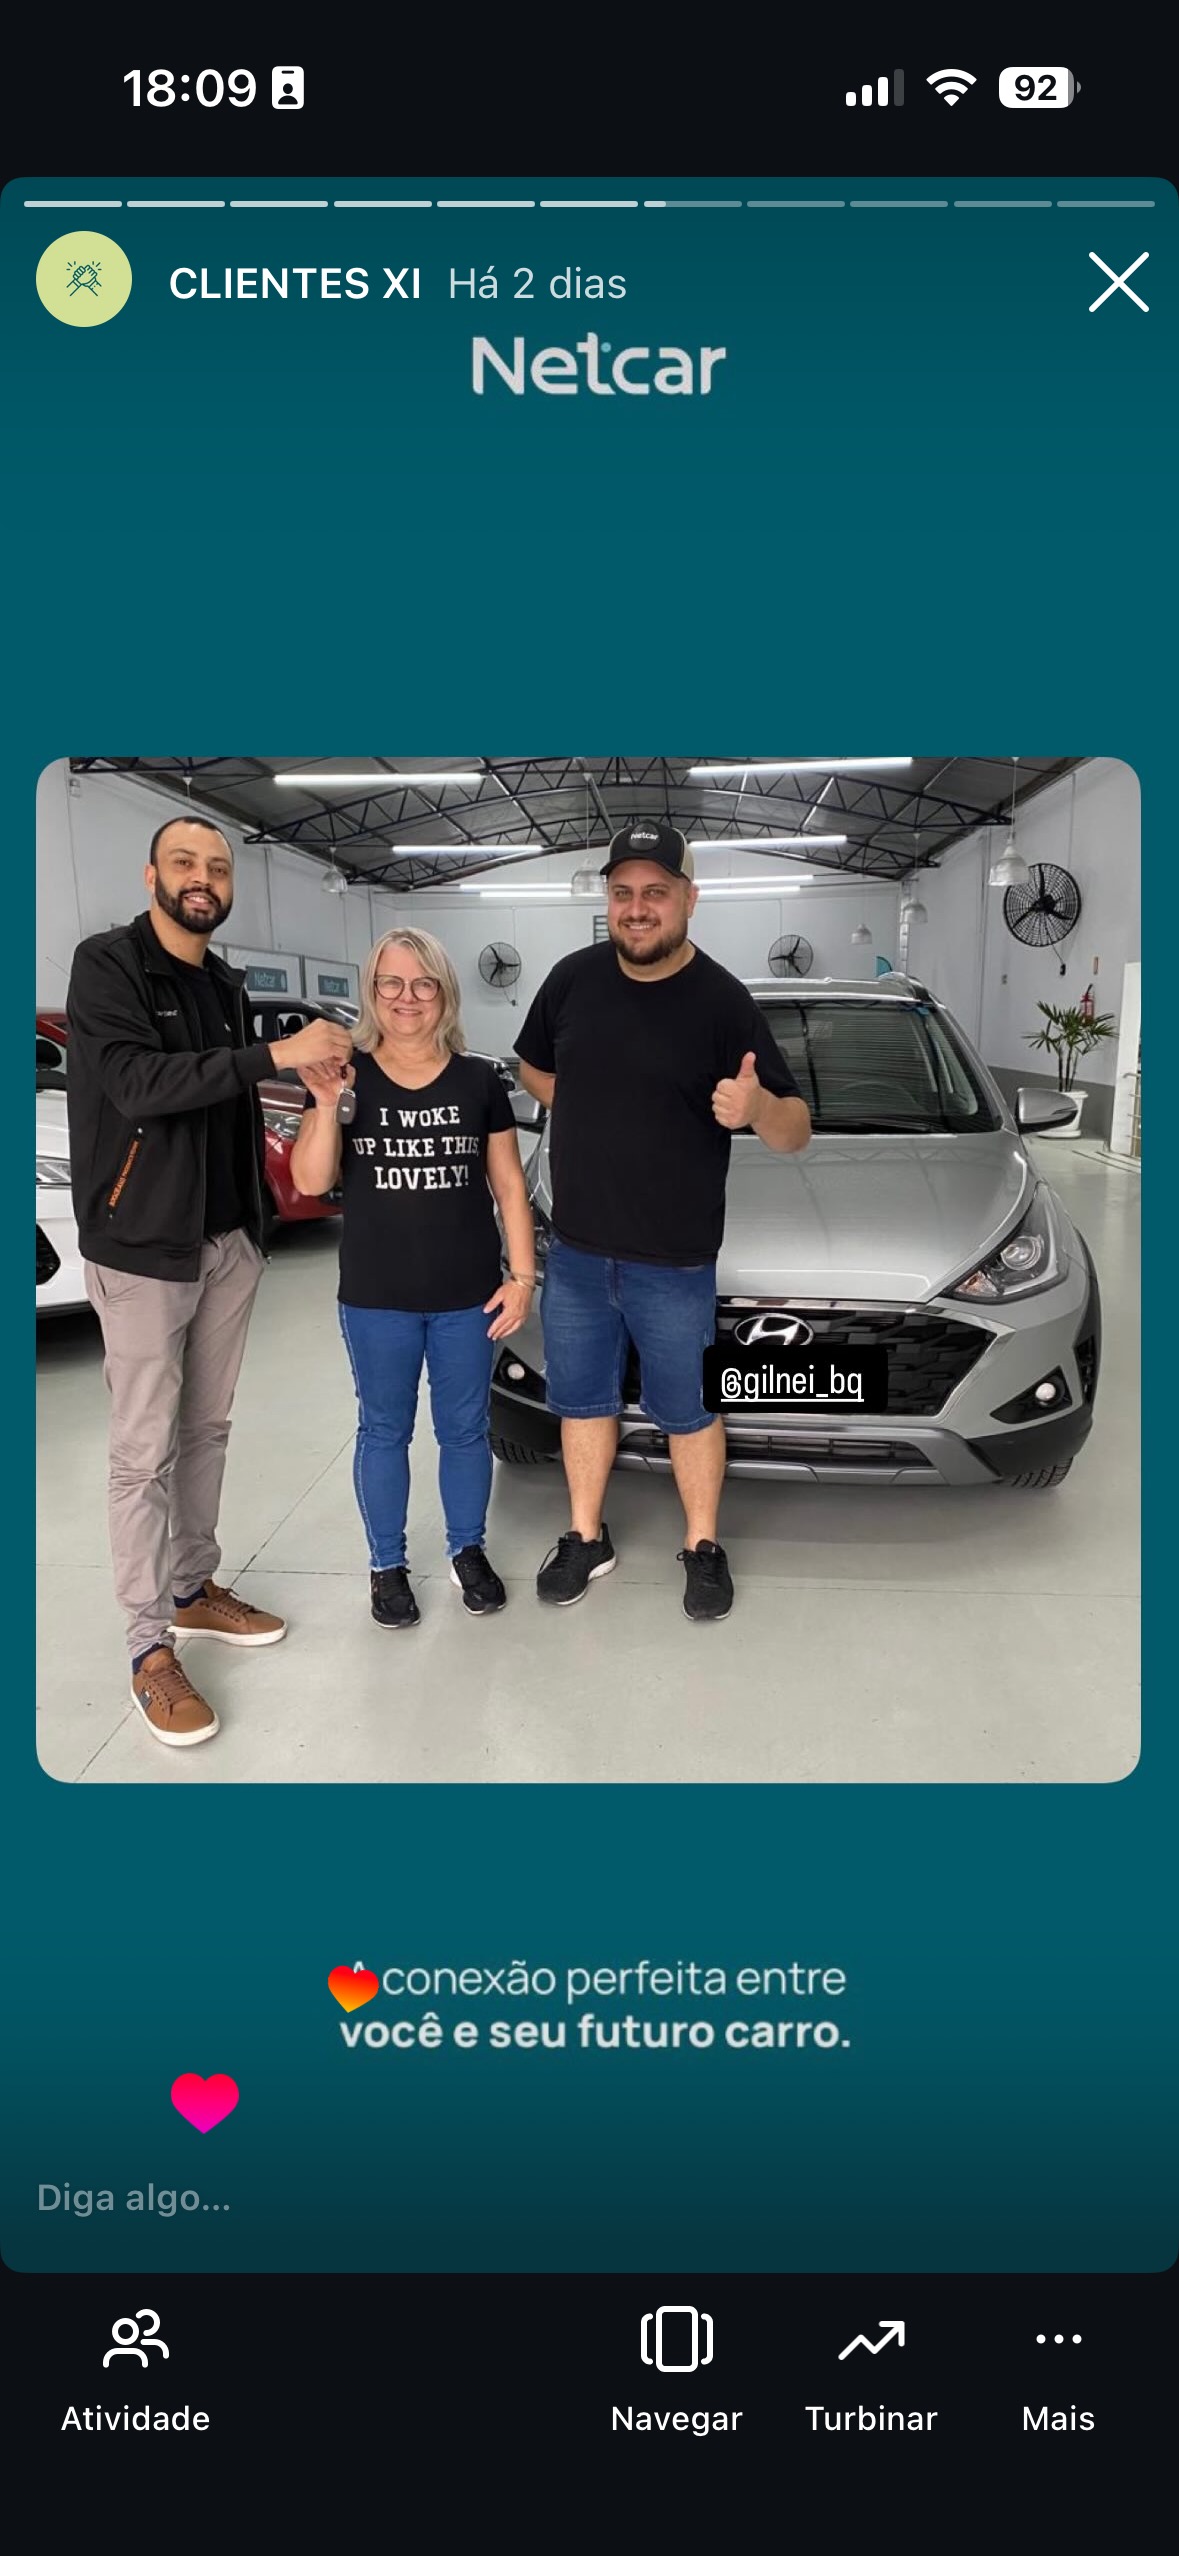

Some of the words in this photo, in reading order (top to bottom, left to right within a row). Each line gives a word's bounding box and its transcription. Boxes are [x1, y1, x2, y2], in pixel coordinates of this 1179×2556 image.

[380, 1107, 389, 1126] I
[397, 1105, 460, 1128] WOKE
[352, 1137, 377, 1156] UP
[383, 1138, 435, 1157] LIKE
[374, 1164, 470, 1190] LOVELY!
